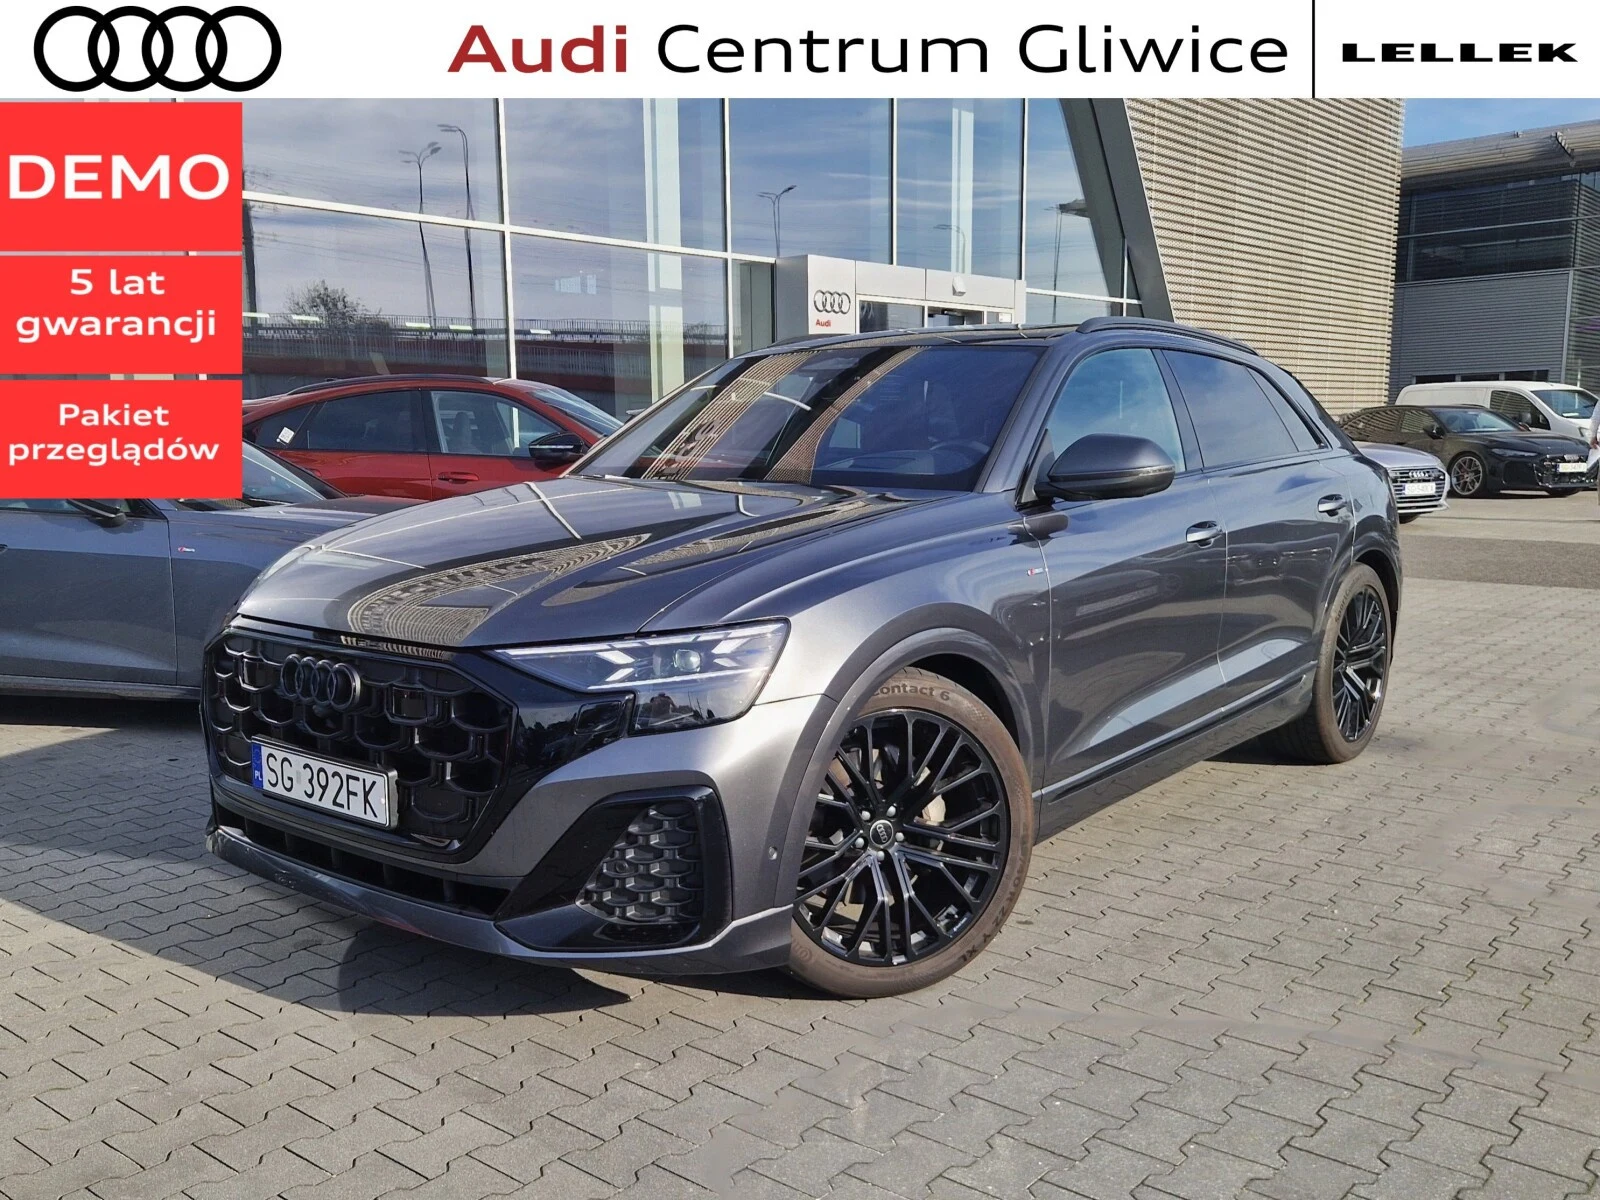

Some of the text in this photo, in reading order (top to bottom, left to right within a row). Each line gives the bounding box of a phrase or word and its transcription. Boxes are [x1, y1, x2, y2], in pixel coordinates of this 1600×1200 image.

[815, 318, 832, 328] Audi
[874, 683, 950, 701] ontact 6
[254, 770, 263, 781] PL
[266, 752, 378, 819] SG 392FK
[960, 944, 978, 962] XL
